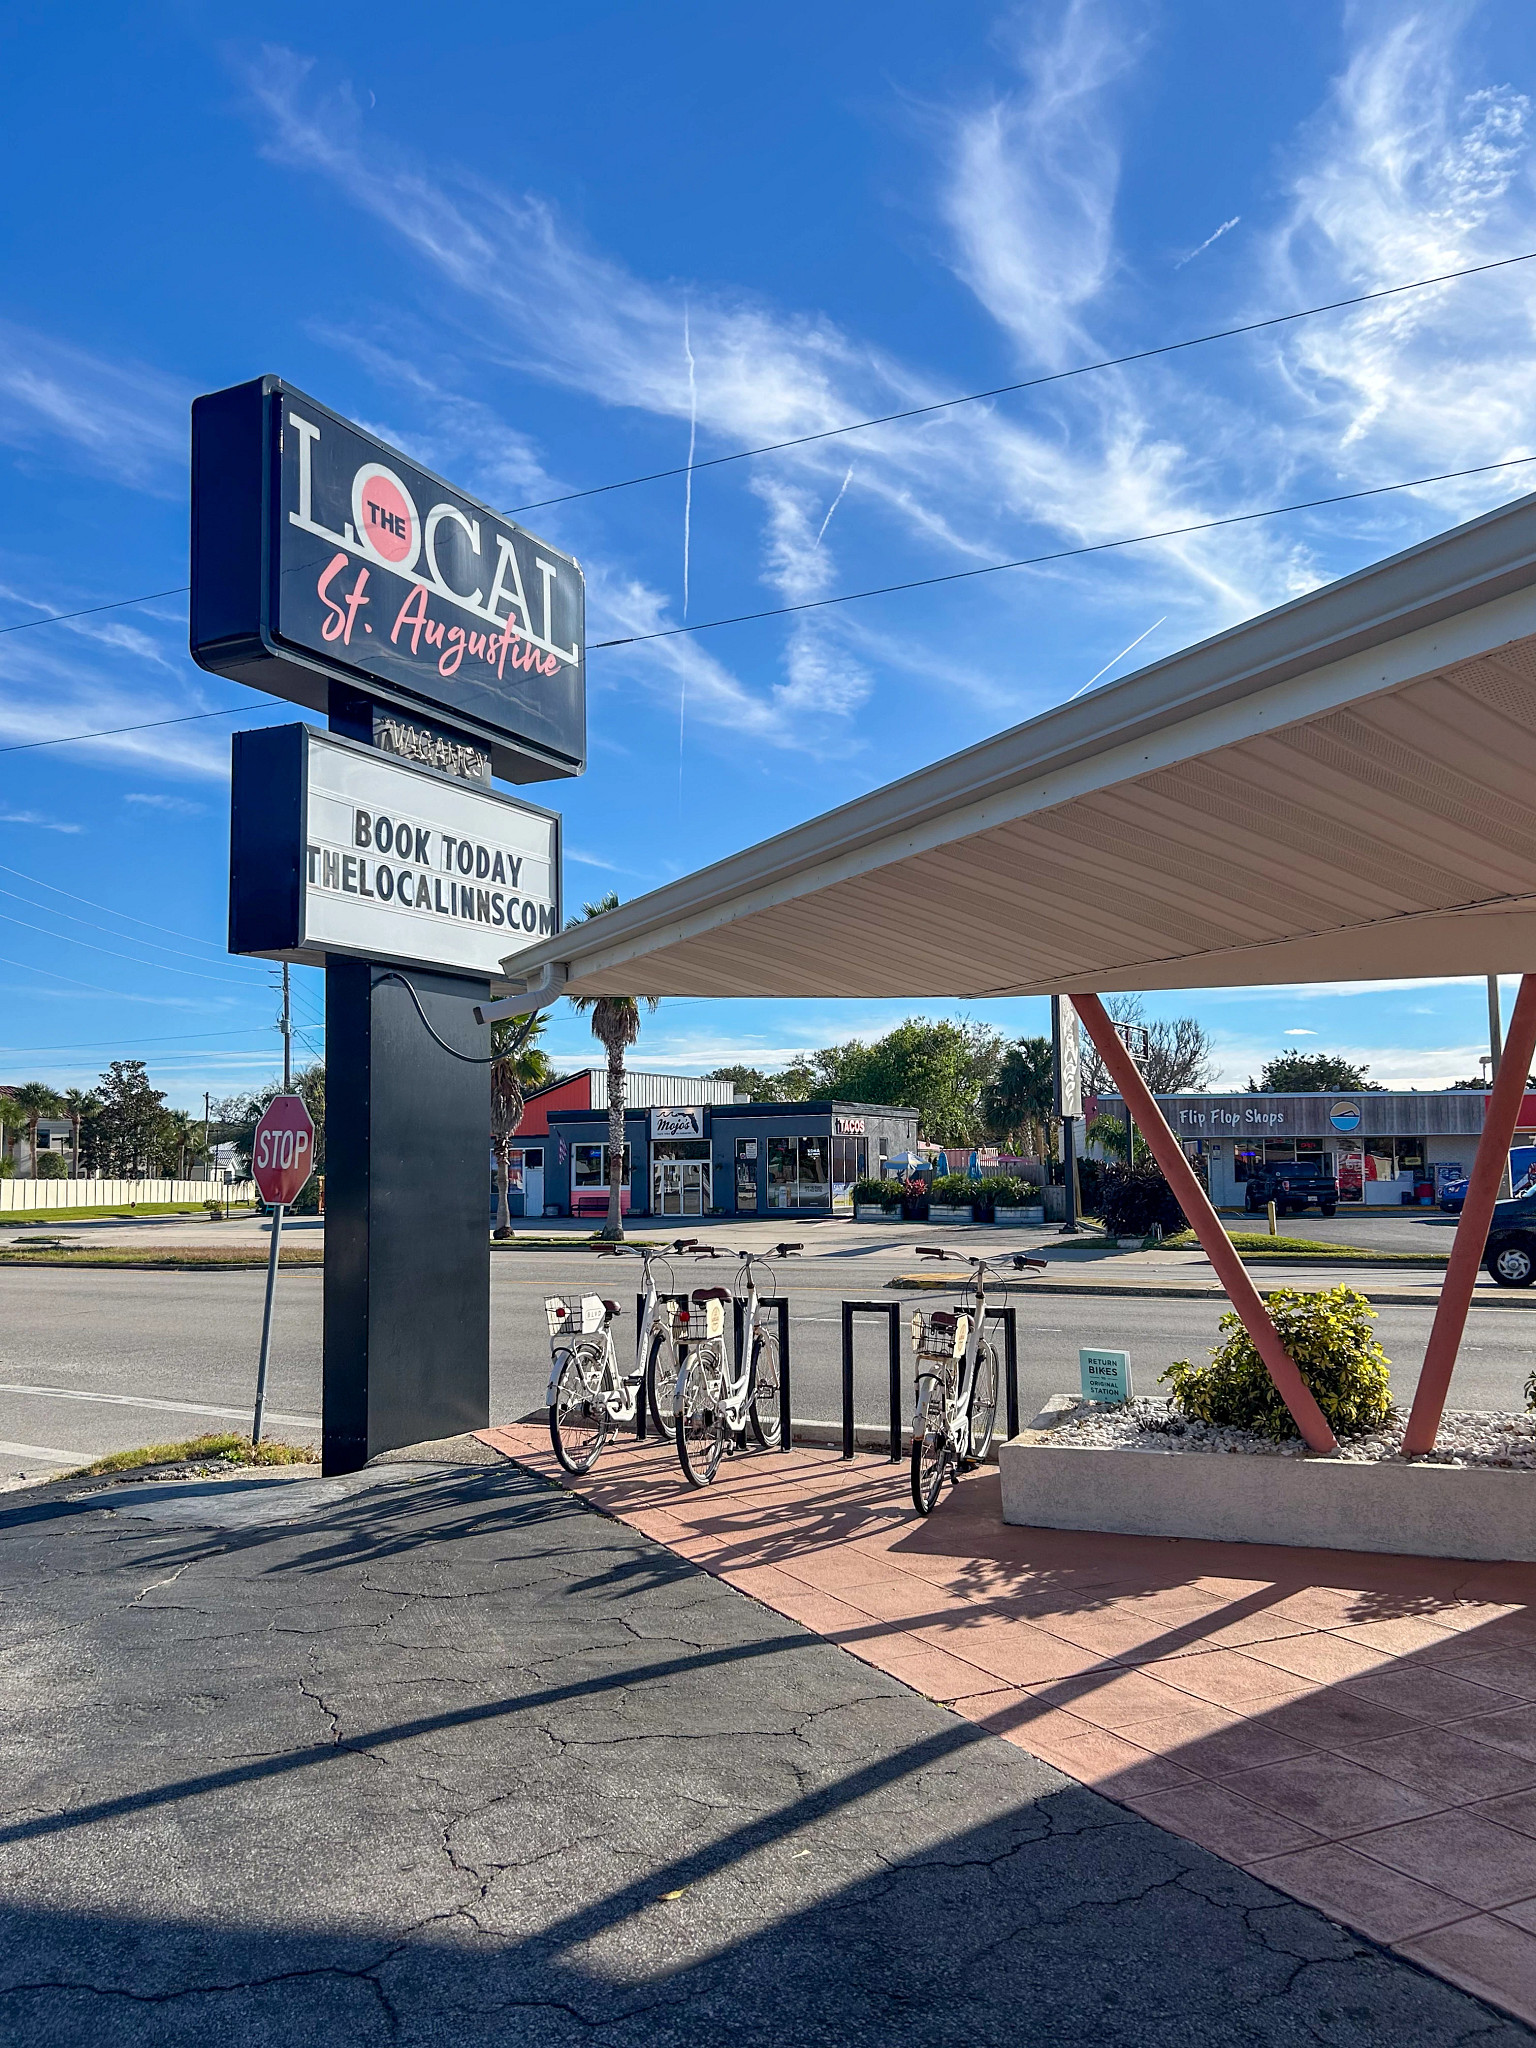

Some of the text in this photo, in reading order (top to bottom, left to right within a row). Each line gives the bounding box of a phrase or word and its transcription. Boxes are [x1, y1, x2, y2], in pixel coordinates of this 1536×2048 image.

[367, 500, 406, 541] THE
[289, 412, 579, 668] LOCAL
[317, 552, 562, 680] St. Augustine
[355, 809, 523, 889] BOOK TODAY
[840, 1119, 865, 1133] TACOS
[1179, 1108, 1284, 1127] Flip Flop Shops
[657, 1119, 690, 1136] Mojo's
[257, 1130, 309, 1169] STOP
[1088, 1358, 1117, 1366] RETURN
[1088, 1366, 1118, 1376] BIKES
[1090, 1387, 1119, 1395] STATION
